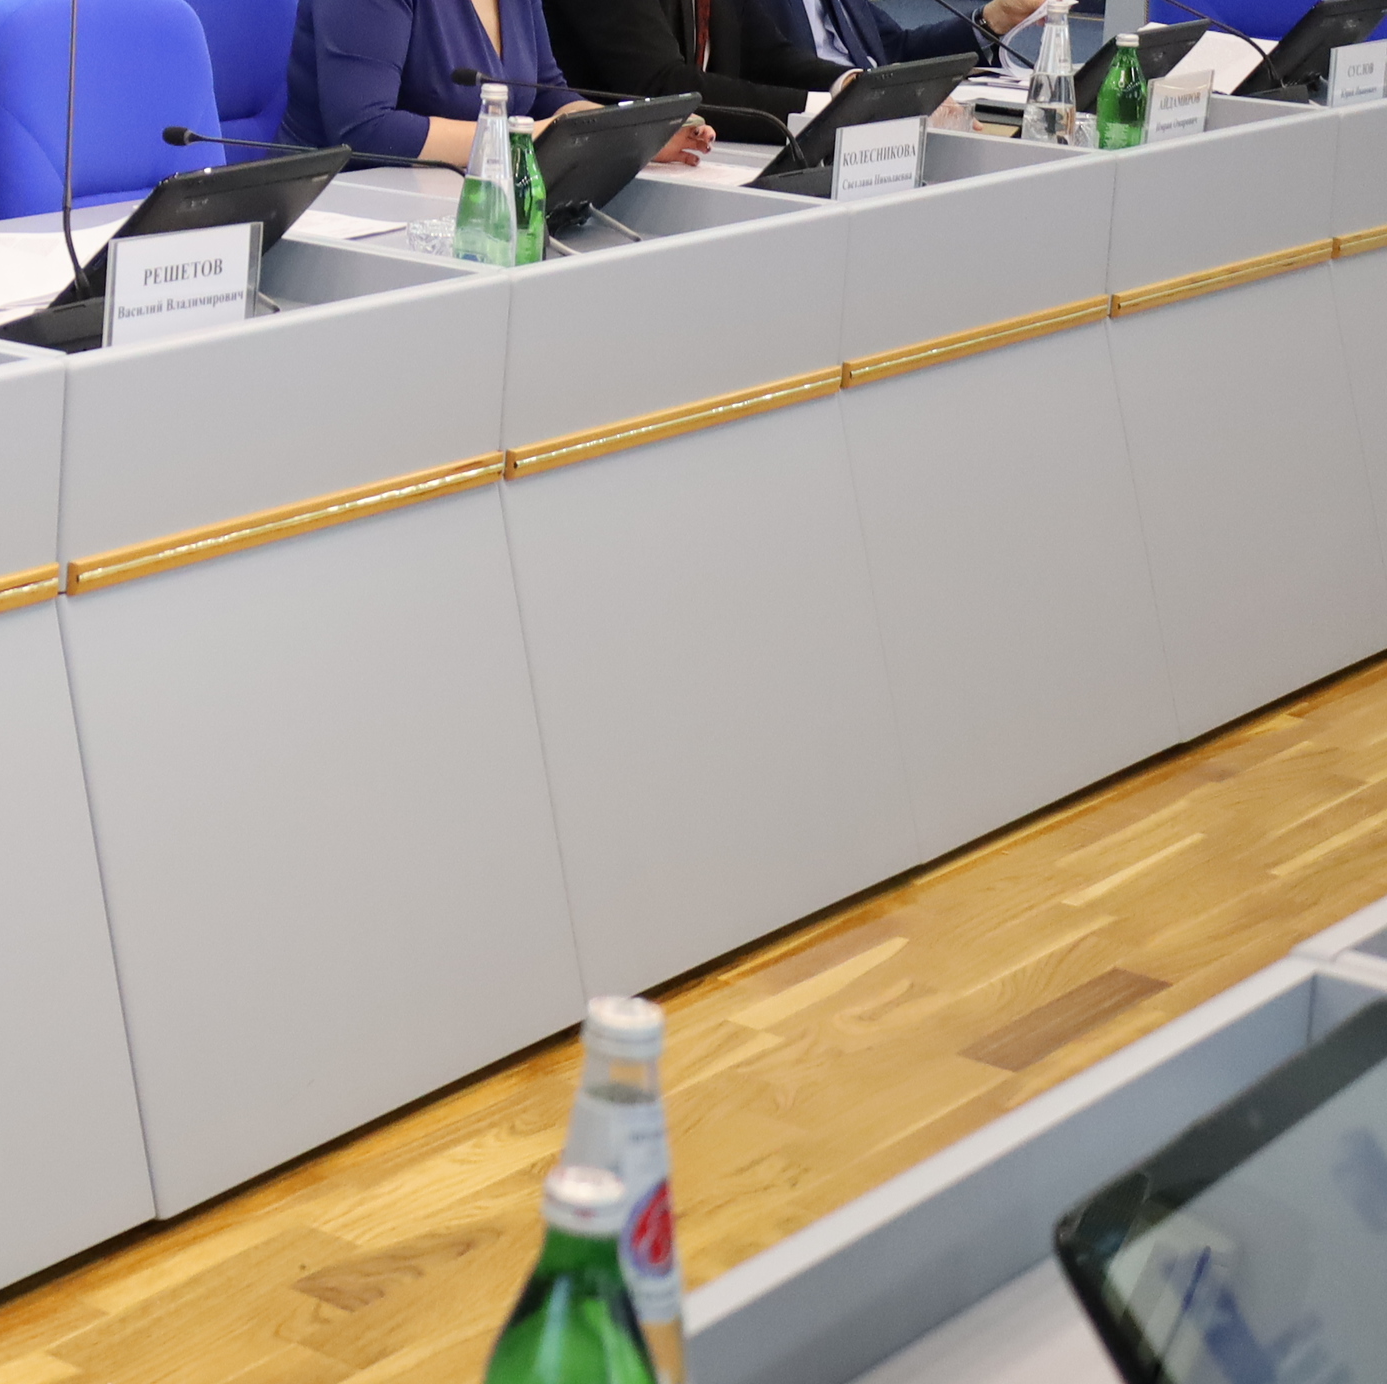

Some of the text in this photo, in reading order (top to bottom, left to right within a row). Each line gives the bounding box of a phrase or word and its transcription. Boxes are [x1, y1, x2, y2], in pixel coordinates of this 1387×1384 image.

[842, 143, 916, 167] КОЛЕСНИКОВА
[842, 172, 913, 191] Светлана Николаевна
[143, 258, 223, 287] РЕШЕТОВ
[117, 290, 244, 320] Василий Владимирович
